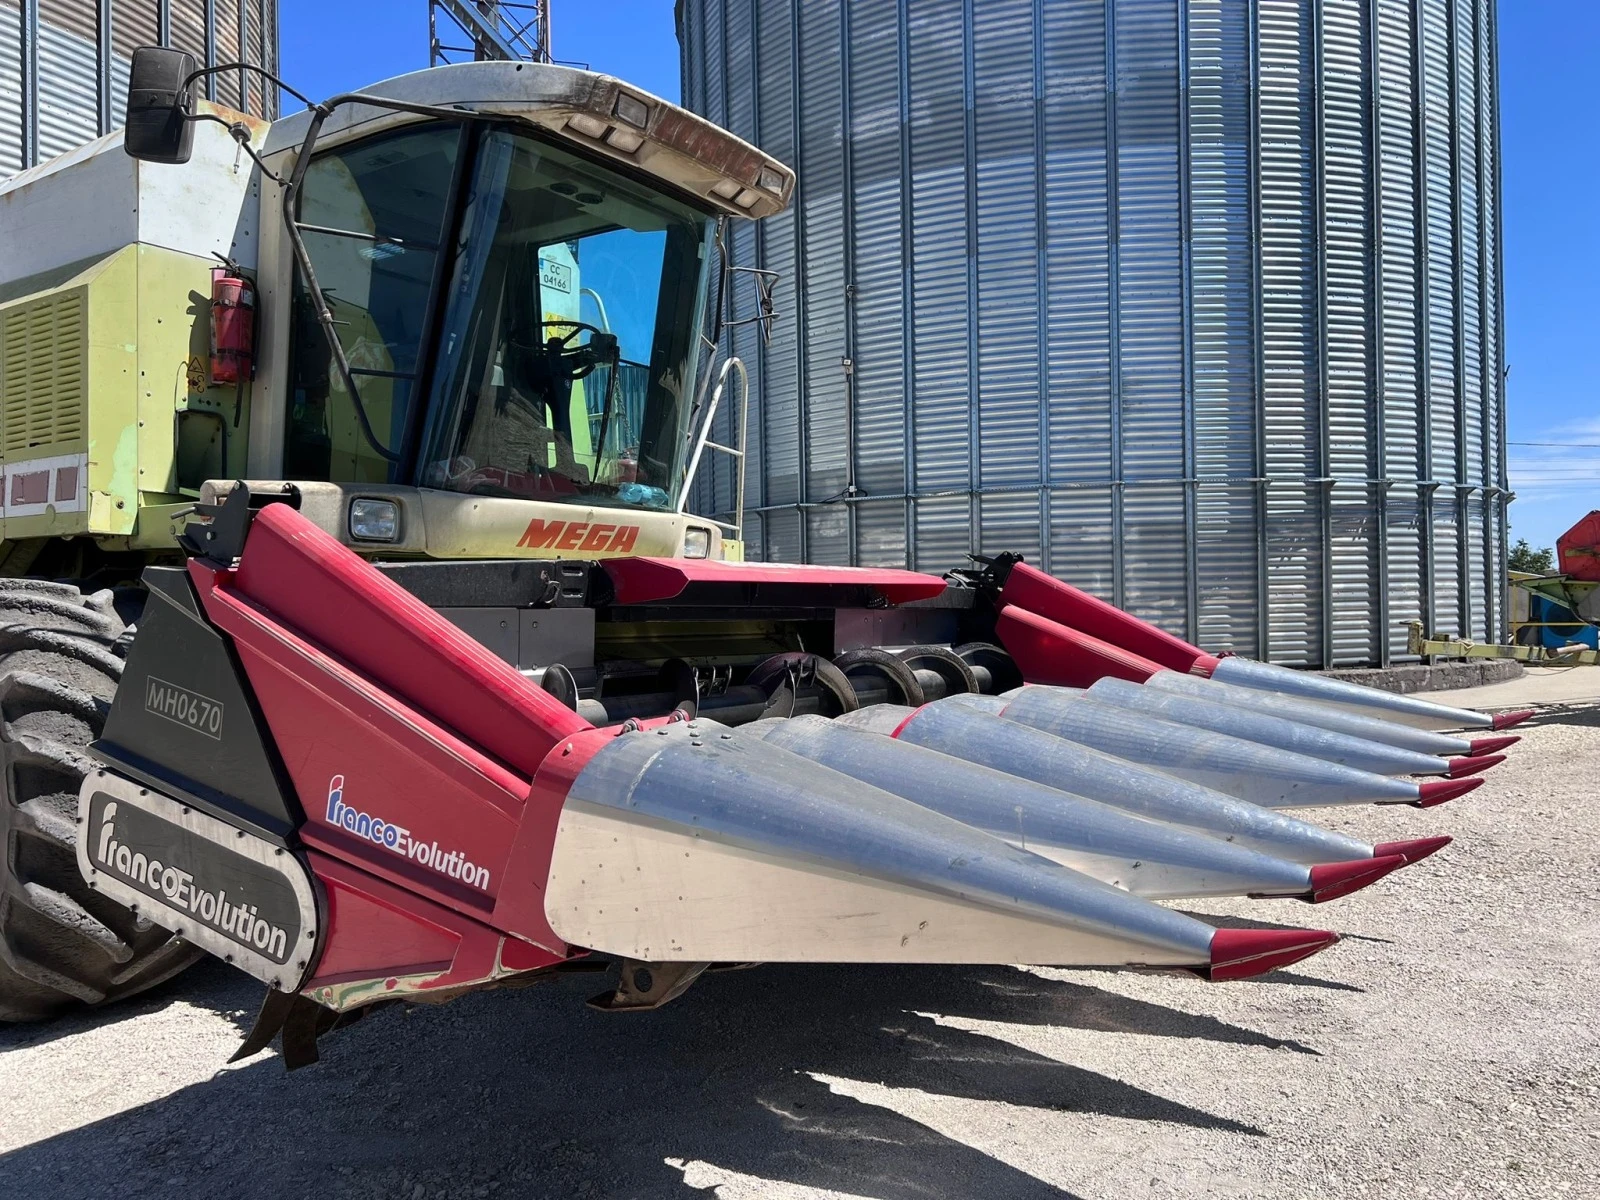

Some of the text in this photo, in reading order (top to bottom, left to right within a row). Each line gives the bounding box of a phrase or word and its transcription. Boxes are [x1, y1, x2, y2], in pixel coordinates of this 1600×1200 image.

[543, 274, 567, 289] 04166
[550, 264, 560, 275] CC
[516, 518, 640, 553] MEGA
[147, 682, 221, 733] MH0670
